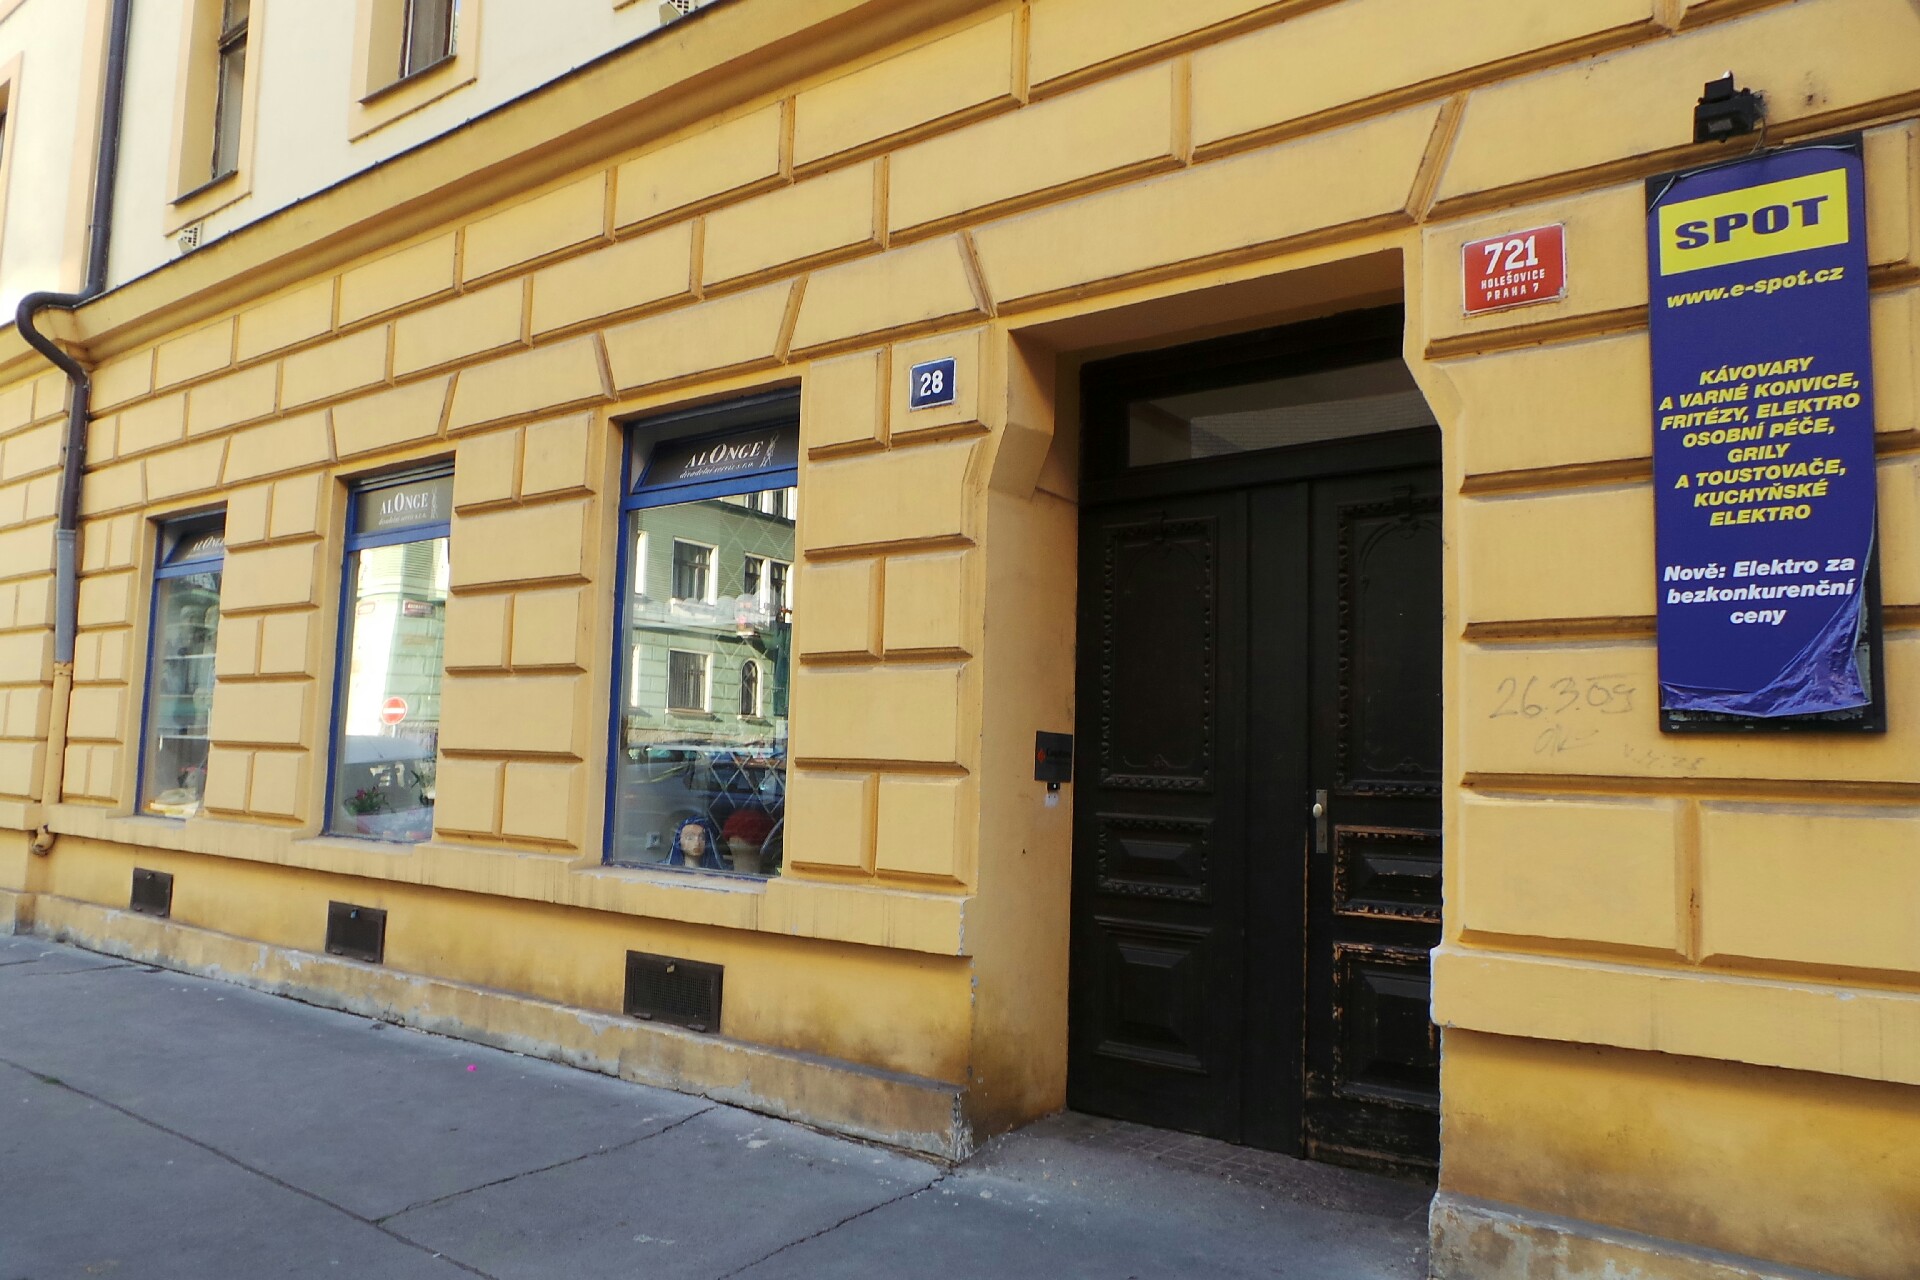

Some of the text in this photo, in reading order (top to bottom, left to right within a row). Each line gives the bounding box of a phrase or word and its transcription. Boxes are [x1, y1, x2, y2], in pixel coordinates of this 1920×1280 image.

[1674, 195, 1829, 250] SPOT
[1484, 235, 1539, 275] 721
[1481, 269, 1545, 290] HOLEŠOVICE
[1487, 283, 1539, 301] PRAHA 7
[1667, 266, 1844, 309] www.e-spot.cz
[920, 370, 943, 396] 28
[1699, 356, 1814, 385] KÁVOVARY
[1659, 373, 1860, 411] A VARNÉ KONVICE,
[1660, 393, 1861, 430] FRITÉZY, ELEKTRO
[1682, 416, 1835, 448] OSOBNÍ PÉČE,
[684, 441, 764, 468] ALONGE
[1727, 443, 1791, 463] GRILY
[1674, 458, 1846, 489] A TOUSTOVAČE,
[379, 492, 429, 516] ALONGE
[1693, 478, 1829, 508] KUCHYŇSKÉ
[1709, 504, 1811, 526] ELEKTRO
[1663, 557, 1855, 582] Nově: Elektro za
[1666, 579, 1856, 604] bezkonkurenční
[1729, 607, 1787, 626] ceny
